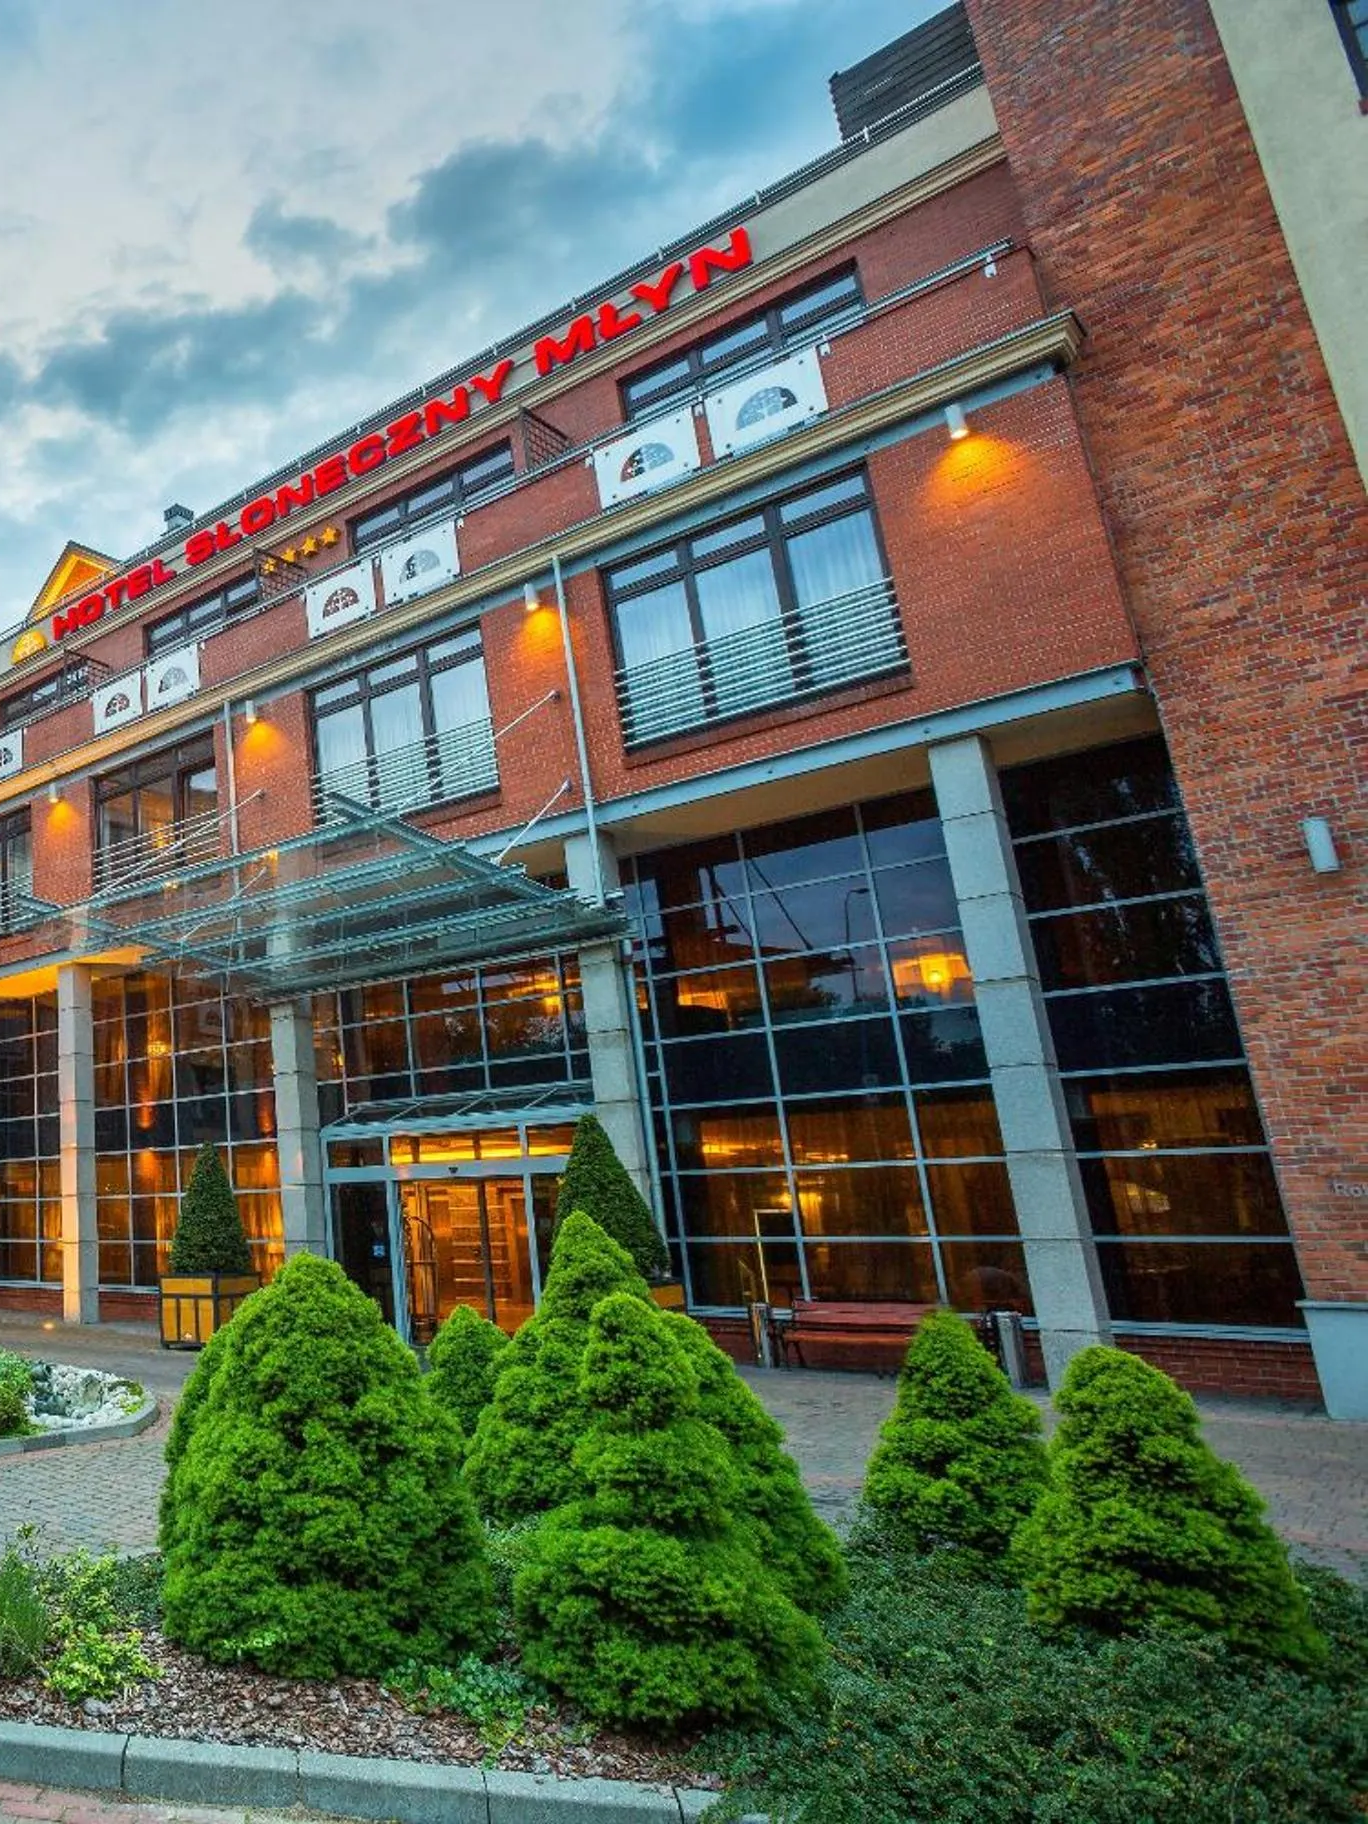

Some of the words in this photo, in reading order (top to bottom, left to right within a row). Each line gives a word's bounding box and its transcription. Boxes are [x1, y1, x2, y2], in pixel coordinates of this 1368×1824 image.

[52, 558, 176, 640] HOTEL
[184, 359, 514, 566] SŁONECZNY
[534, 226, 753, 376] MŁYN
